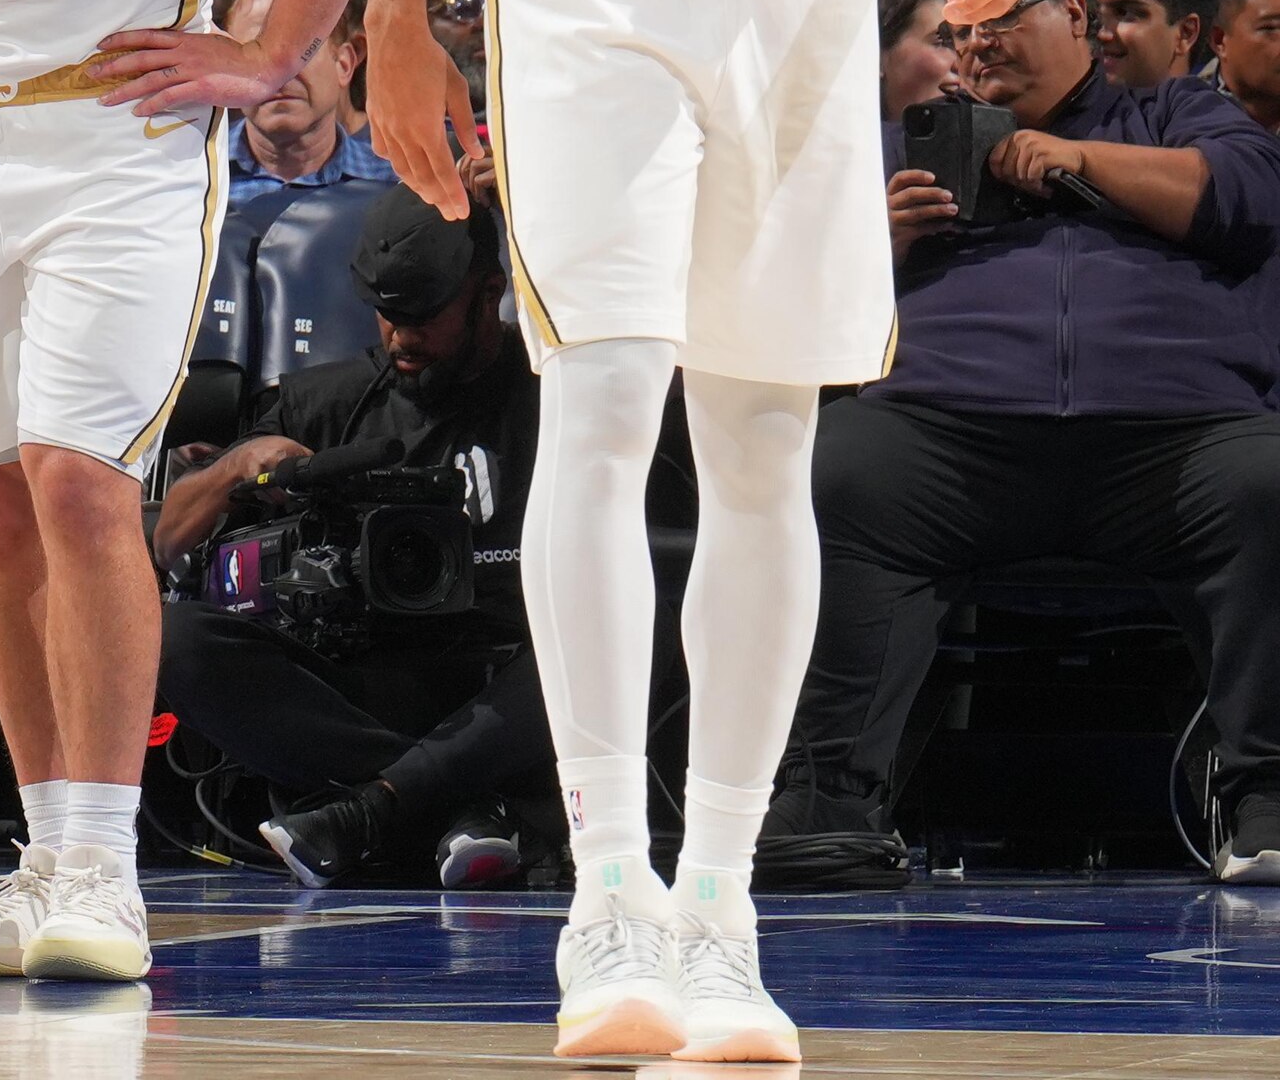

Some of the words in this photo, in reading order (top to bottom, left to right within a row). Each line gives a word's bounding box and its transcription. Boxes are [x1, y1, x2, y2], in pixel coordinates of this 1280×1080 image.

[300, 37, 322, 62] 1998
[213, 299, 237, 315] SEAT
[294, 318, 313, 334] SEC
[473, 549, 521, 564] eacoc
